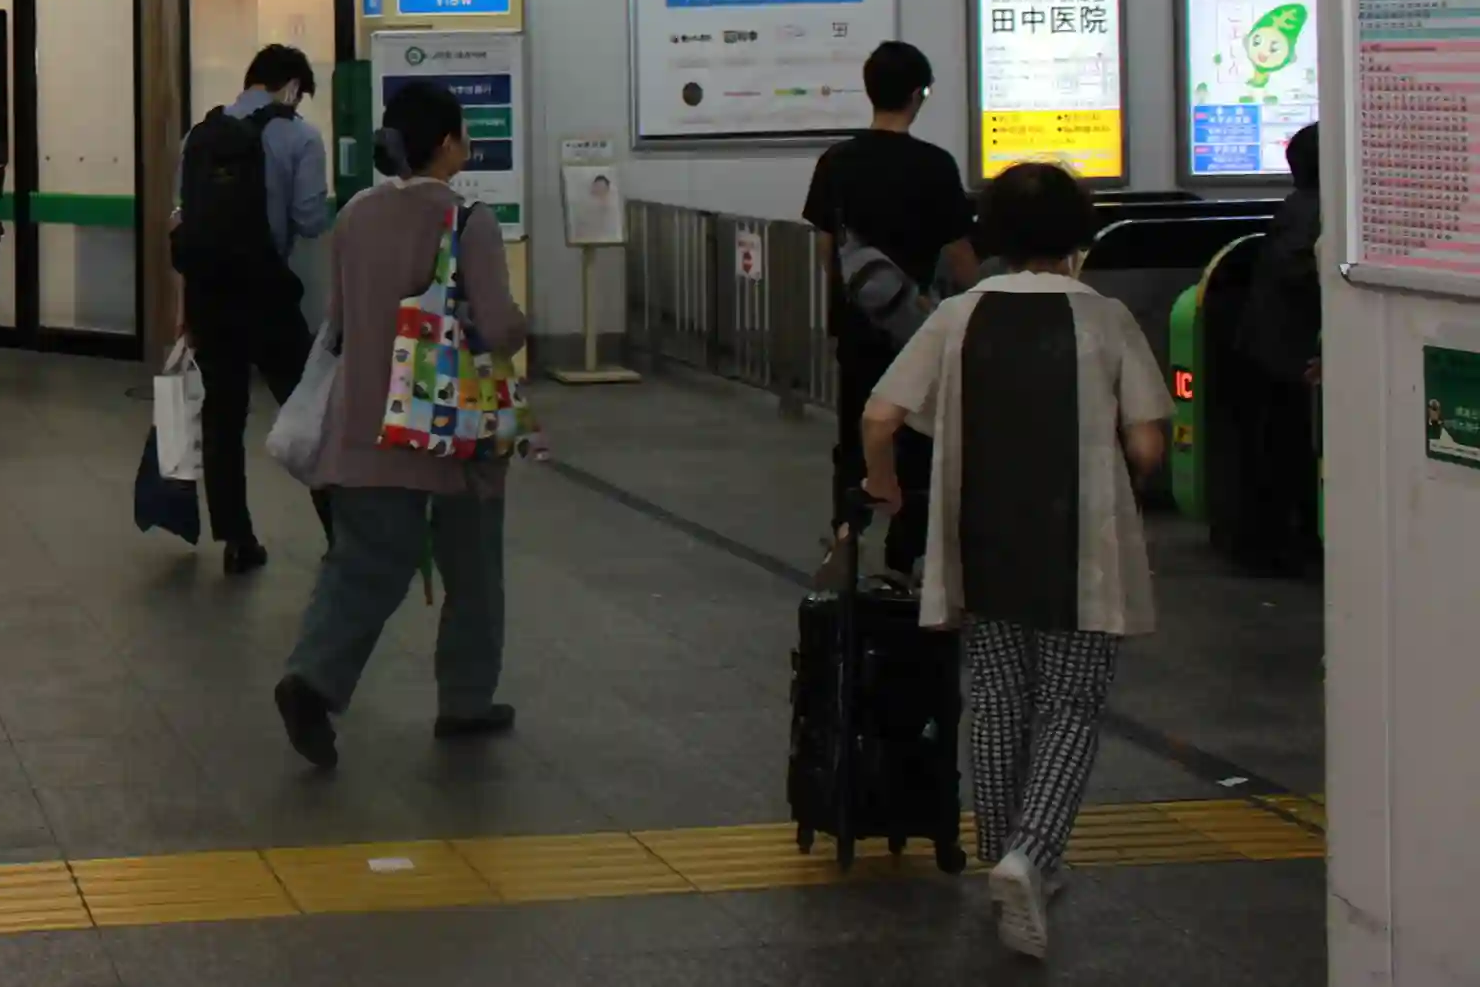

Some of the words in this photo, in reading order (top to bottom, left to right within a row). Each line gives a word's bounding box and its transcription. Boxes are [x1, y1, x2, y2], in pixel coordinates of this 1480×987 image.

[991, 5, 1108, 35] 田中医院
[1176, 370, 1193, 399] IC
